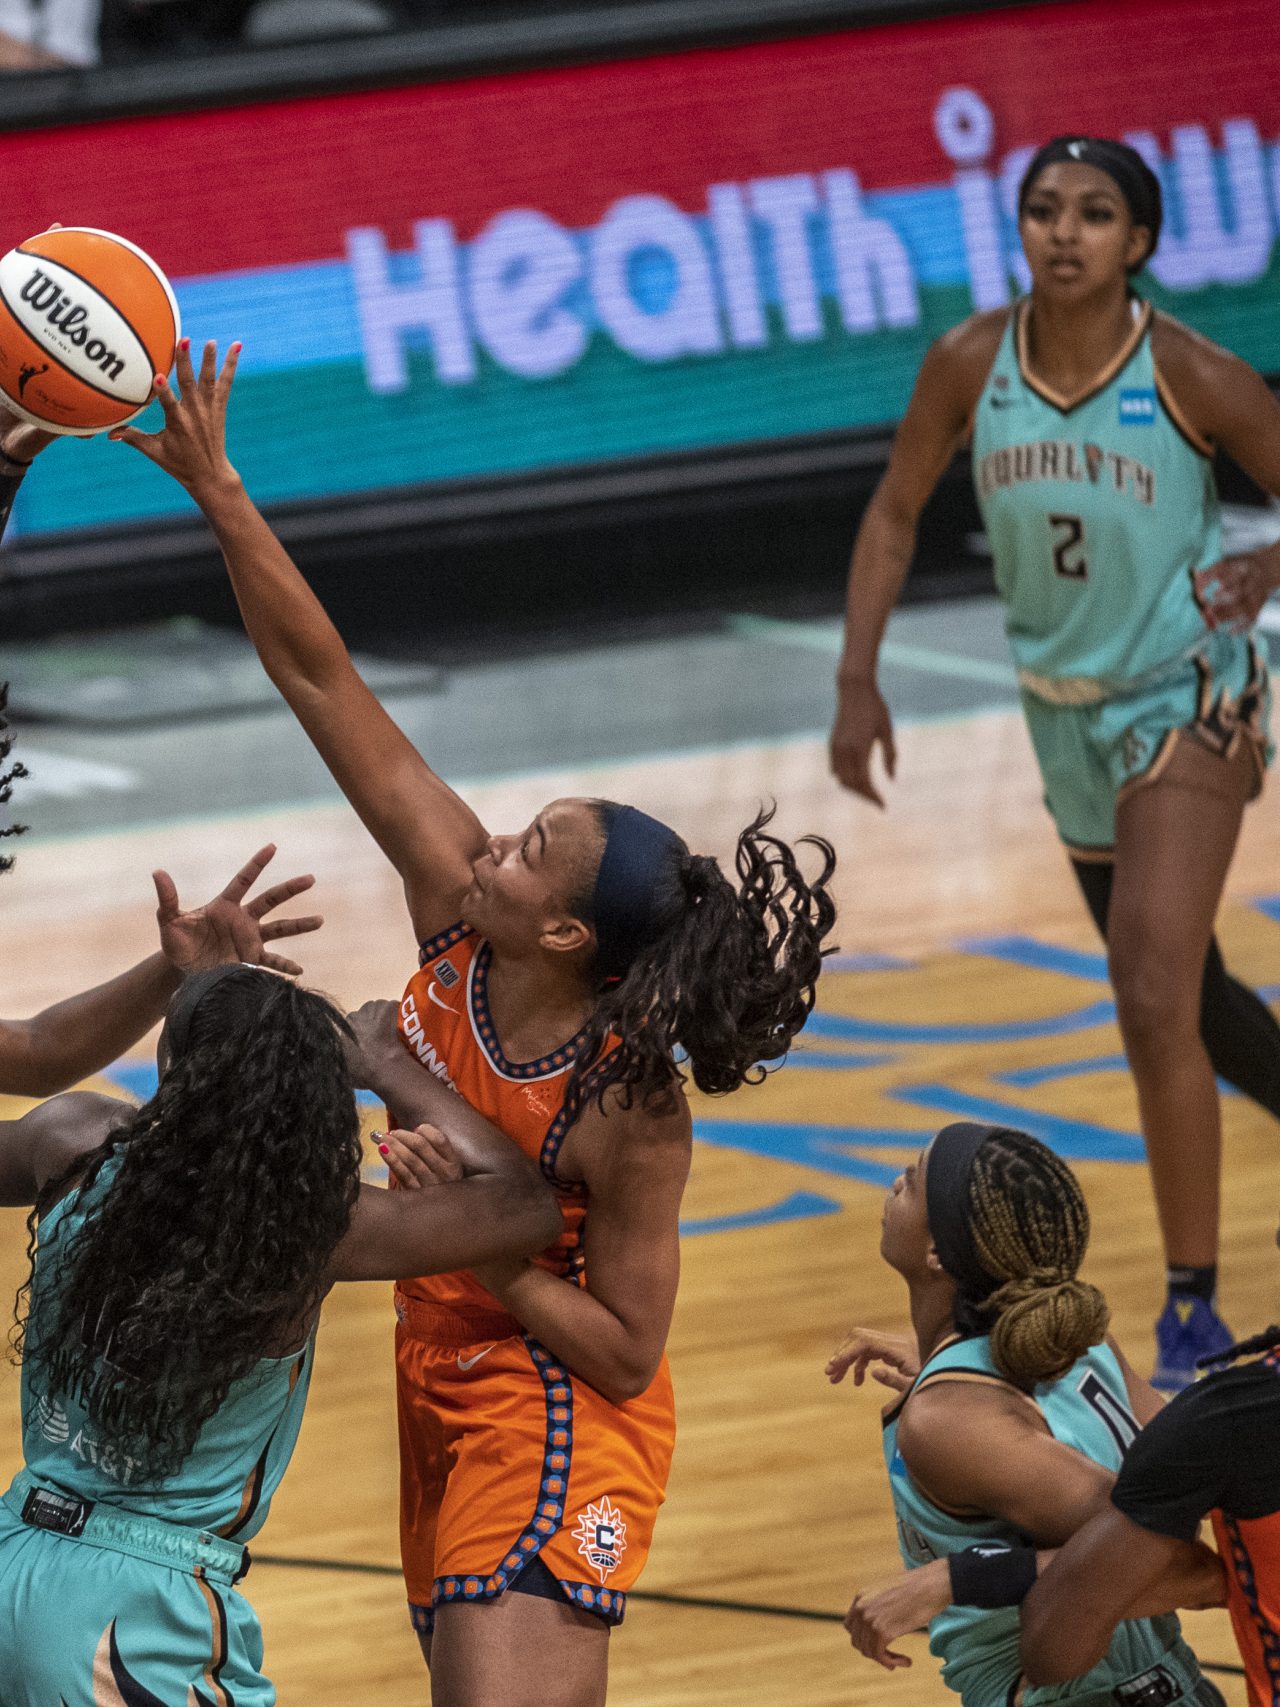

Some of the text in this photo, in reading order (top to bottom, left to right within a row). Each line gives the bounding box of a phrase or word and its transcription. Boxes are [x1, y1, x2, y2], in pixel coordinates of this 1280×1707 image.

[20, 267, 126, 383] Wilson
[1049, 512, 1089, 582] 2
[596, 1524, 614, 1551] C
